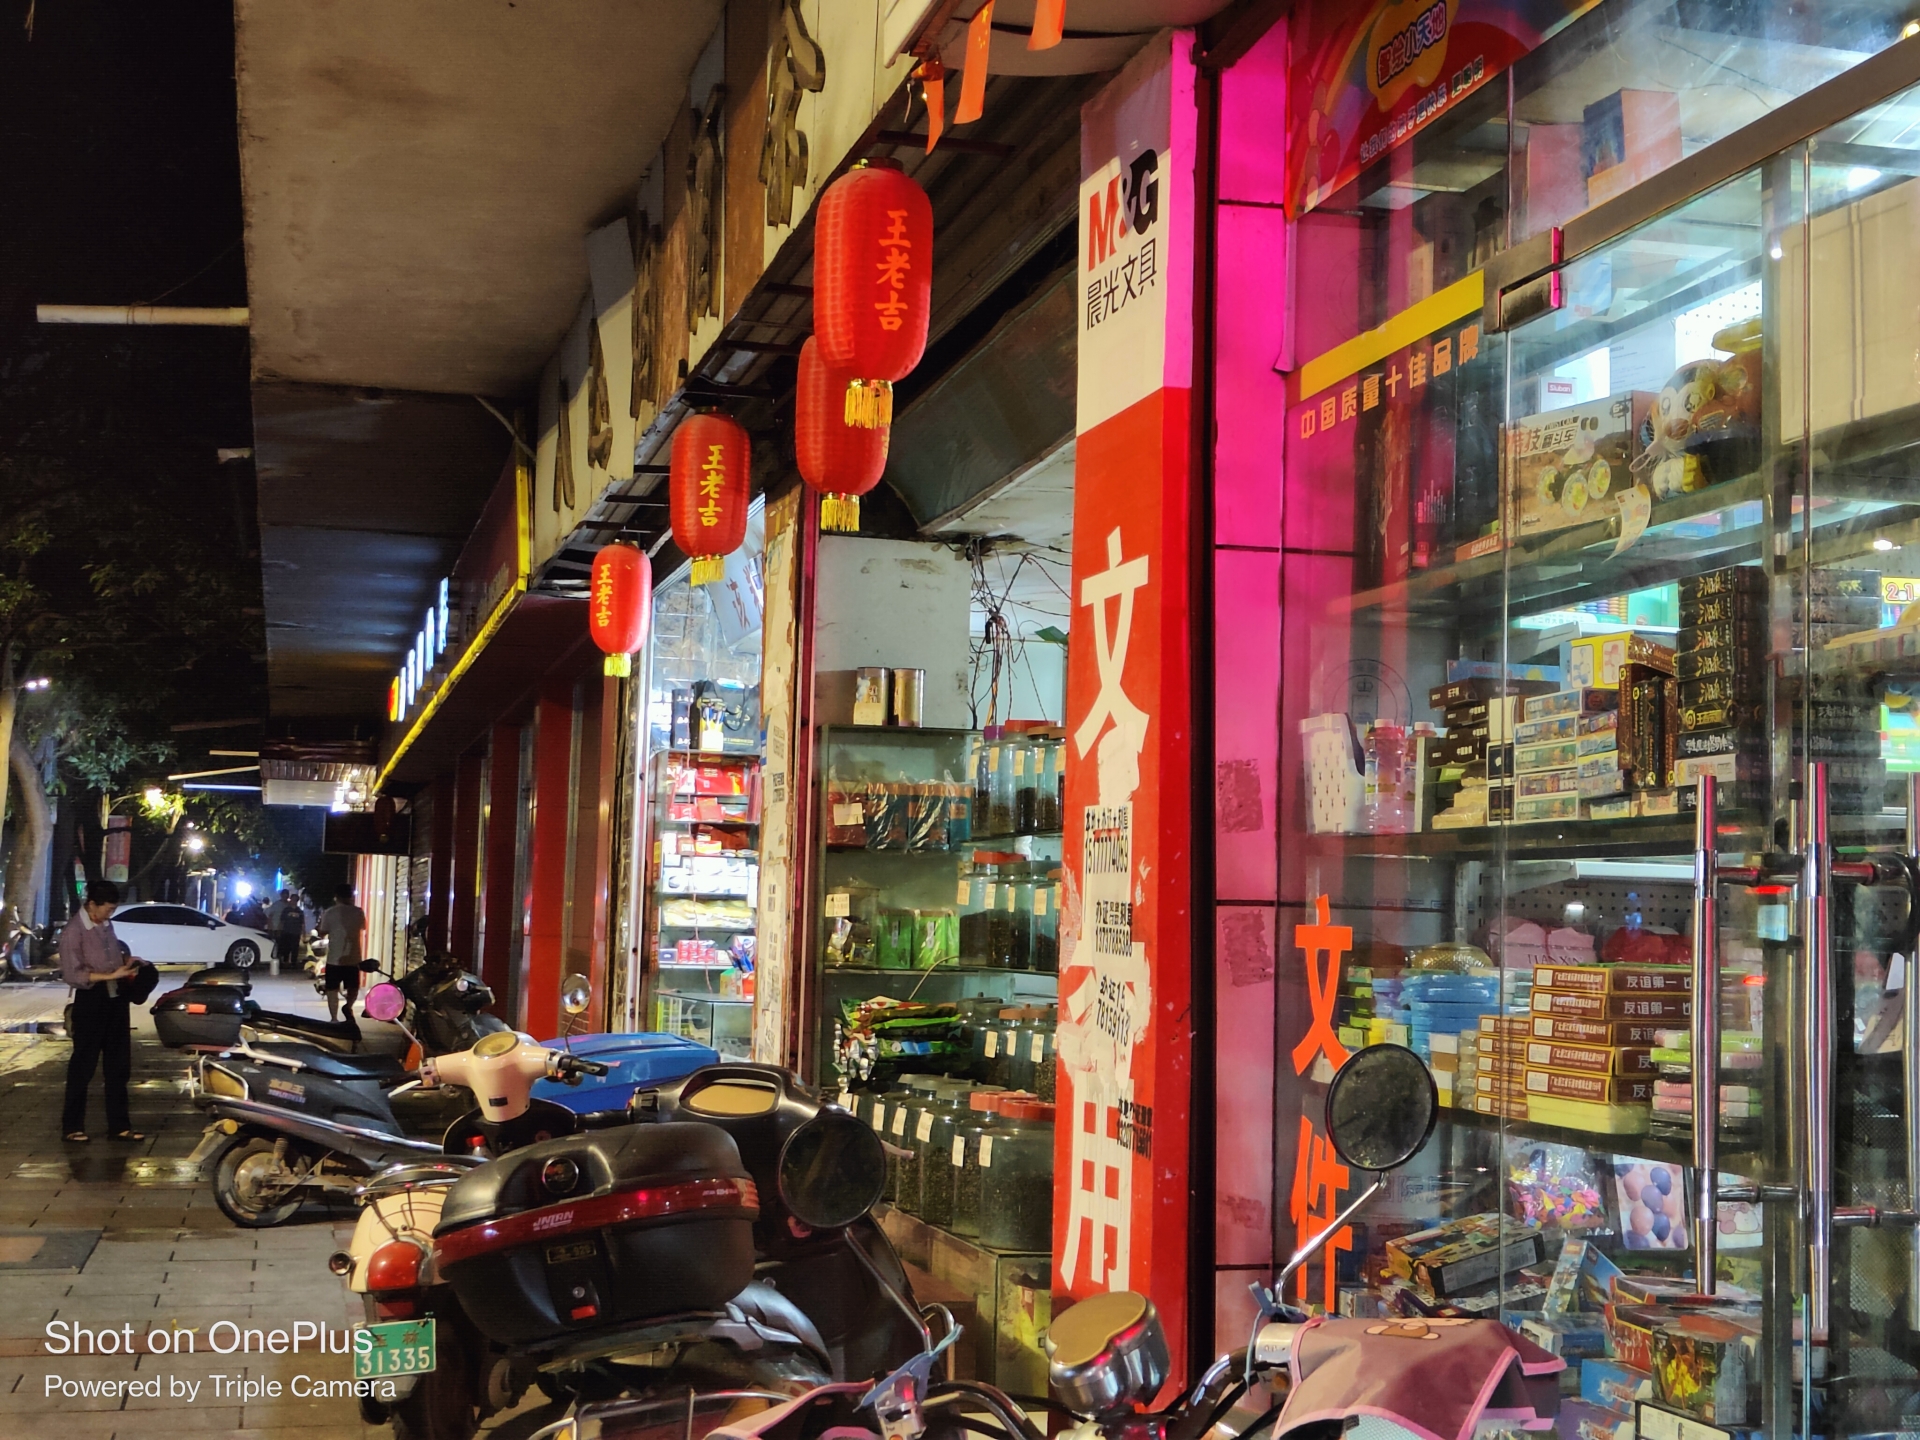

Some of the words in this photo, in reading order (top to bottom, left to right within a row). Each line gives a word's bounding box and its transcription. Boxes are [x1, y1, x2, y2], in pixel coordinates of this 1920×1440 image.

[1088, 149, 1159, 272] M&G
[874, 209, 911, 331] 王老吉
[1087, 239, 1157, 331] 晨光文具
[1301, 325, 1479, 440] 中国质量十佳品牌
[1549, 384, 1571, 393] Sluban
[698, 444, 727, 528] 王老吉
[596, 563, 613, 628] 王老吉
[1624, 1001, 1676, 1015] 友谊第一
[1626, 975, 1677, 988] 友谊第一
[360, 1346, 430, 1375] 31335
